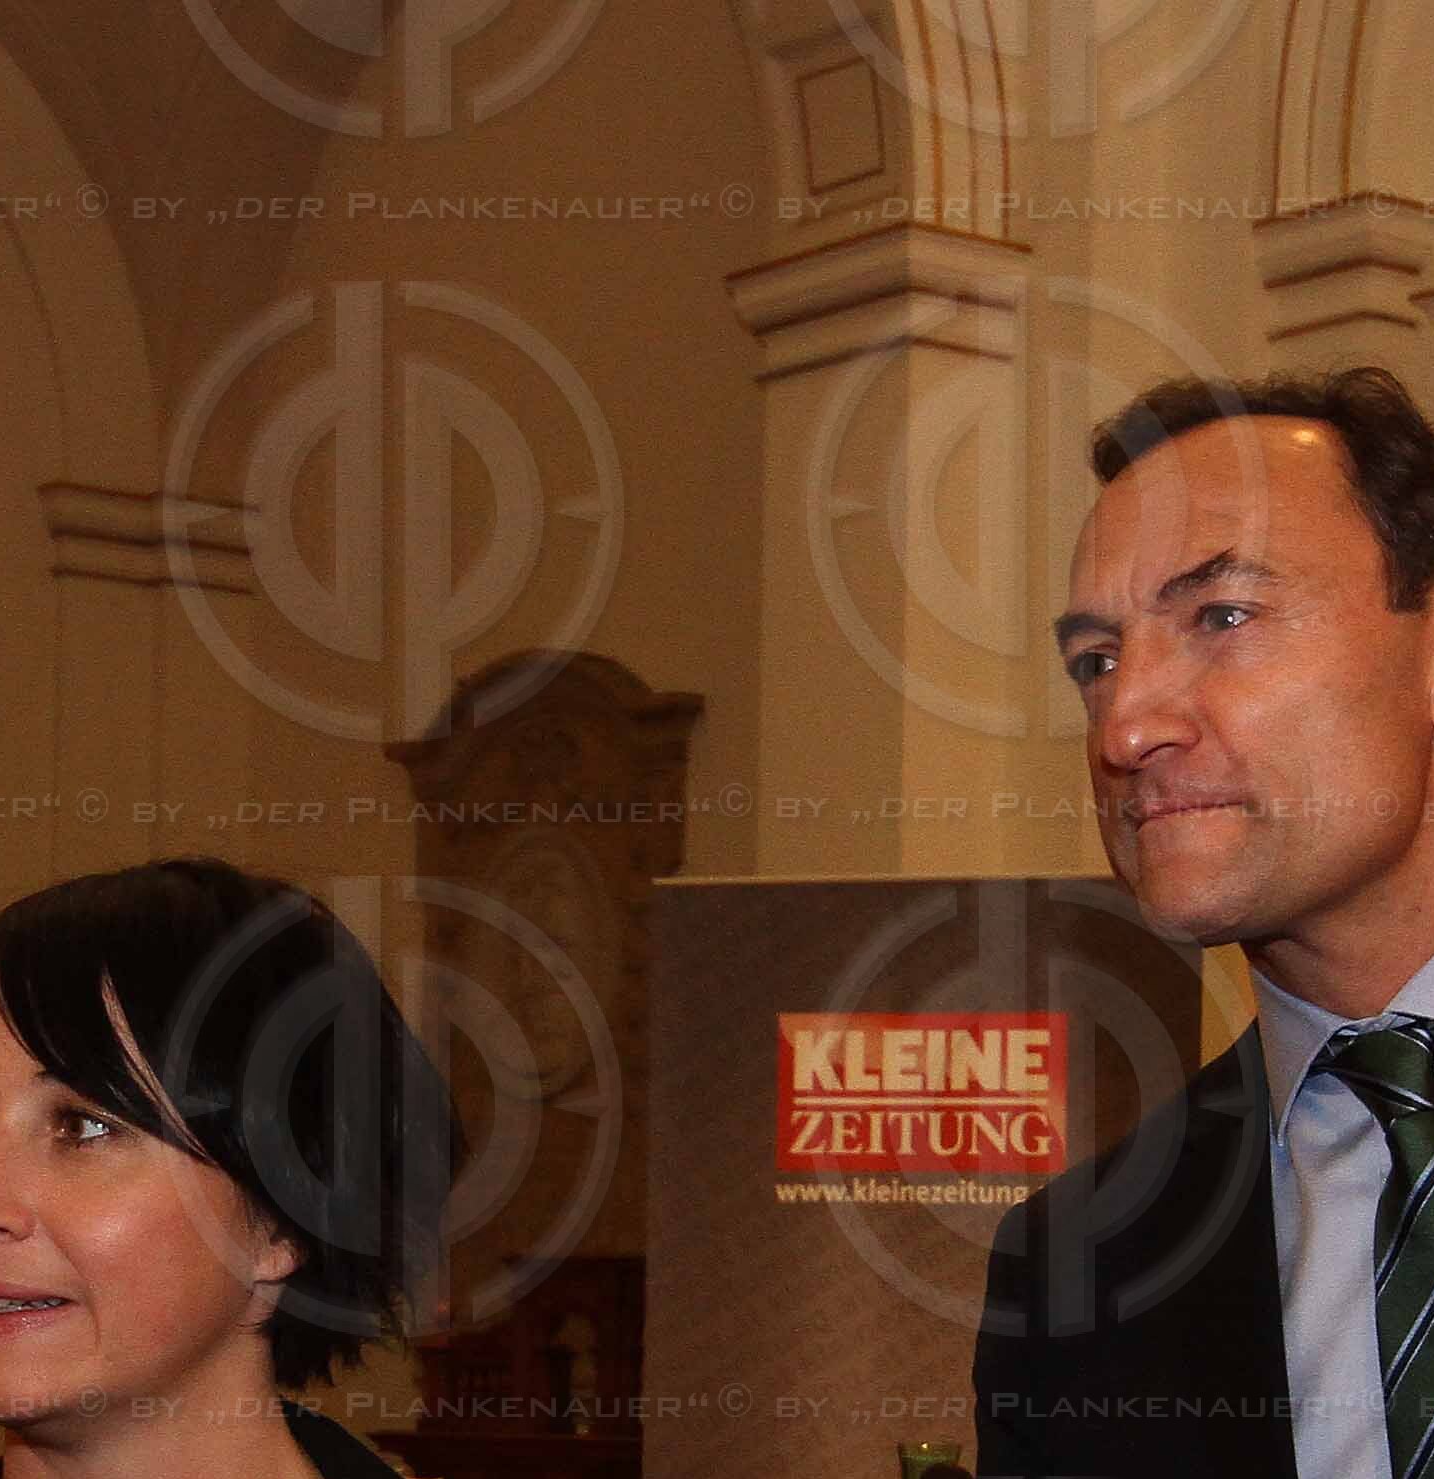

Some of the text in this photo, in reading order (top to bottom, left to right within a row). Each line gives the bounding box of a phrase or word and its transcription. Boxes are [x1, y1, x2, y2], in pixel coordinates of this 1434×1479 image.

[792, 1029, 1050, 1091] KLEINE
[790, 1110, 1050, 1155] ZEITUNG
[775, 1178, 1030, 1205] www.kleinezeitung
